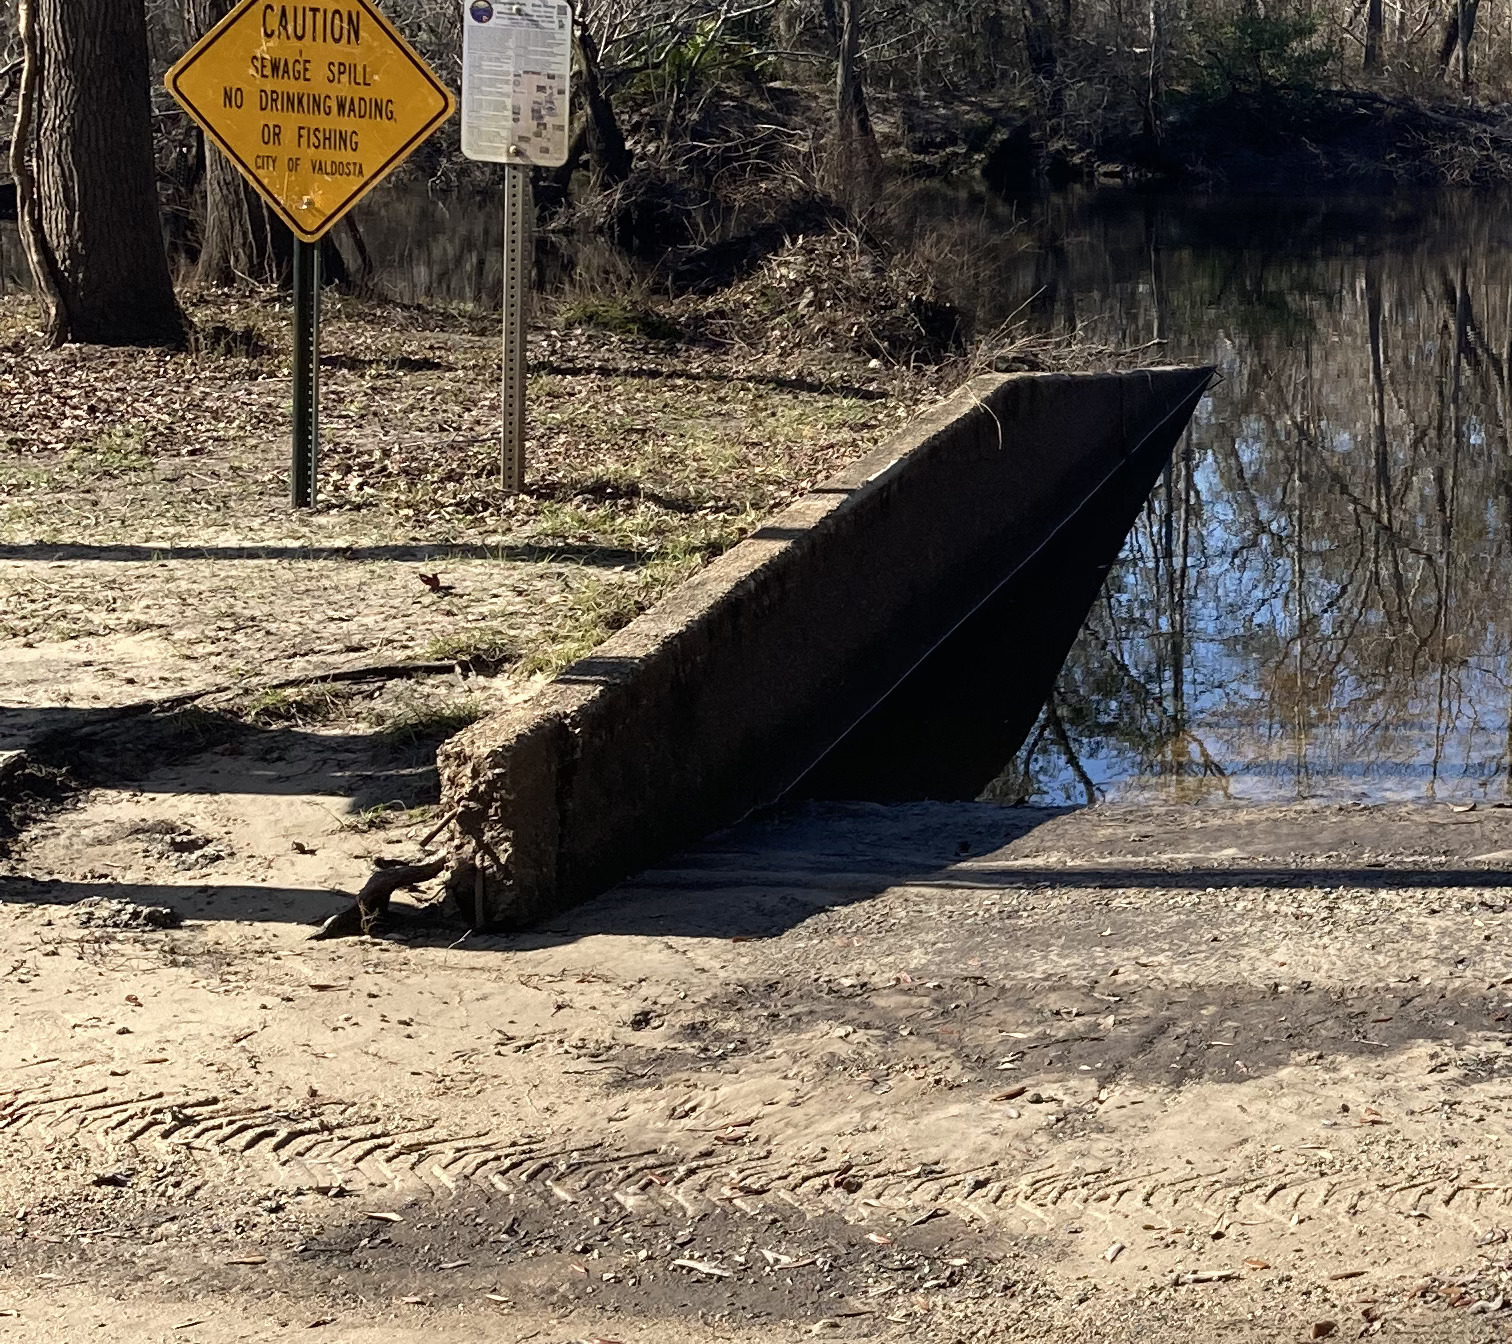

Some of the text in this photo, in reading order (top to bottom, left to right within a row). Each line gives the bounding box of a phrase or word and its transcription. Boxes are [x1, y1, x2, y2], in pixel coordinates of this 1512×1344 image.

[262, 3, 361, 46] CAUTION
[250, 55, 372, 87] SEWAGE SPILL
[223, 86, 244, 109] NO
[259, 89, 332, 117] DRINKING
[261, 123, 360, 152] OR FISHING
[254, 153, 365, 178] CITY OF VALDOSTA
